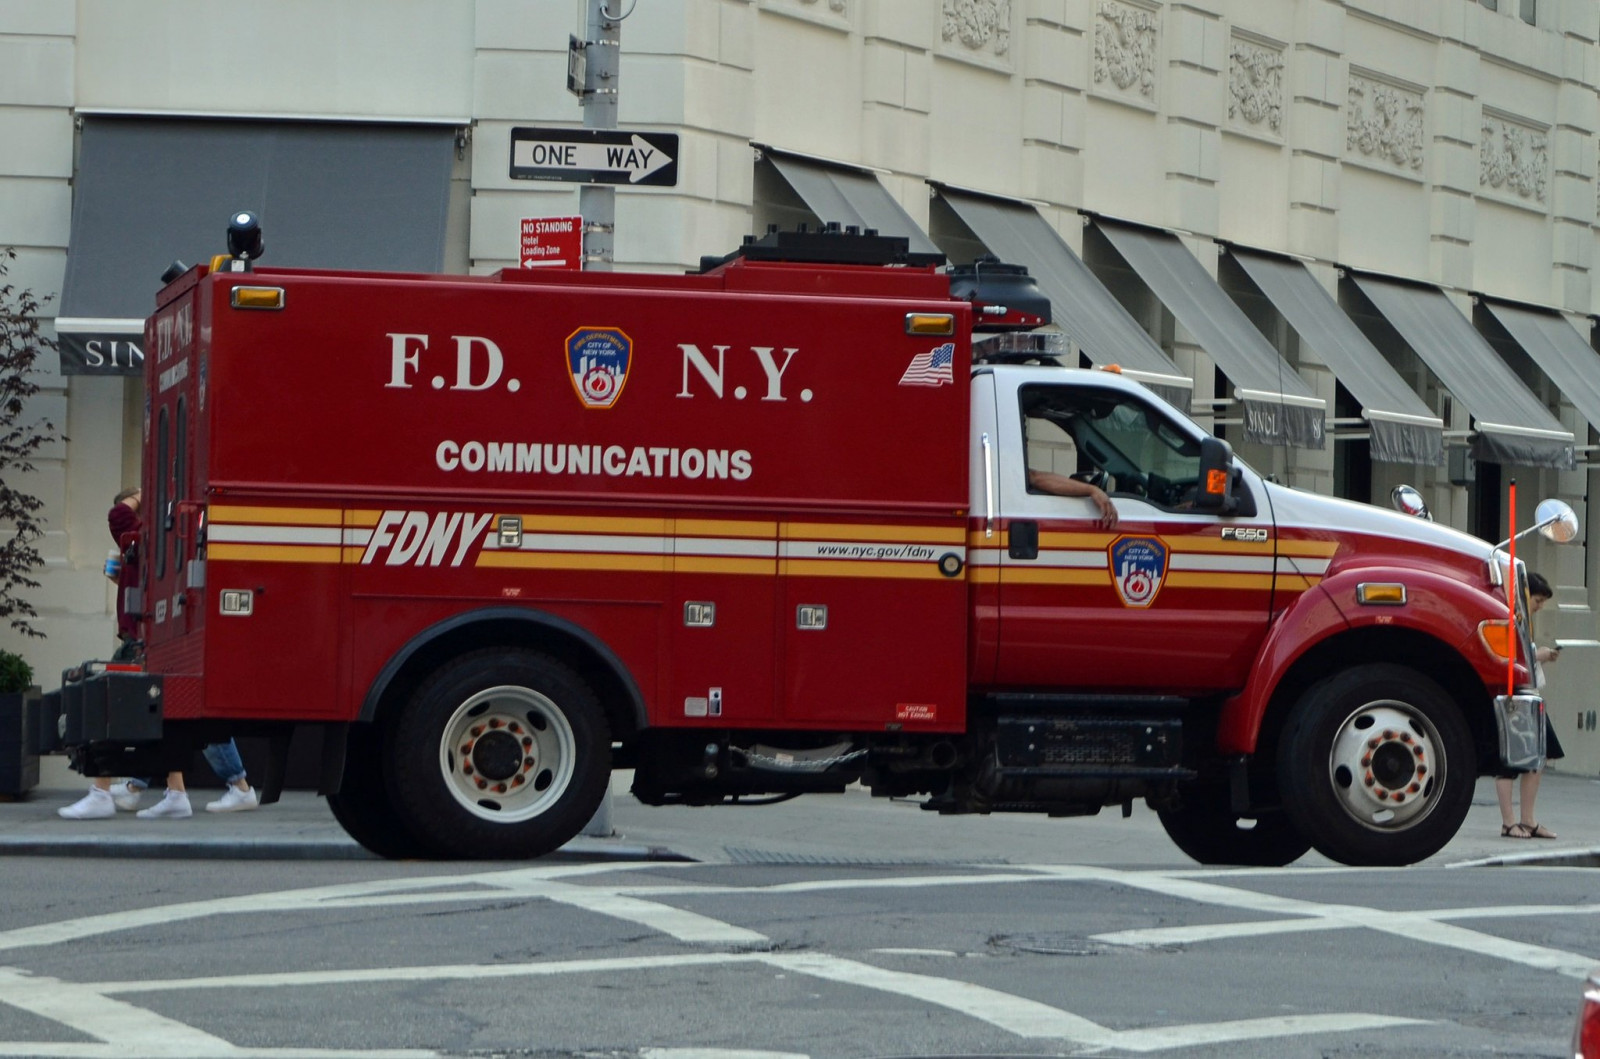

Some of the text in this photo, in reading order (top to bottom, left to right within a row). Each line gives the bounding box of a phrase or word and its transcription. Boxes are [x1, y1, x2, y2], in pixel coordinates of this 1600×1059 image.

[532, 144, 654, 169] ONE WAY
[523, 221, 573, 234] NO STANDING
[522, 236, 539, 245] Hotel
[522, 245, 560, 256] Loading Zone
[384, 332, 813, 403] F.D. N.Y.
[435, 440, 752, 480] COMMUNICATIONS
[361, 510, 493, 567] FDNY
[817, 544, 935, 560] www.nyc.gov/fdny
